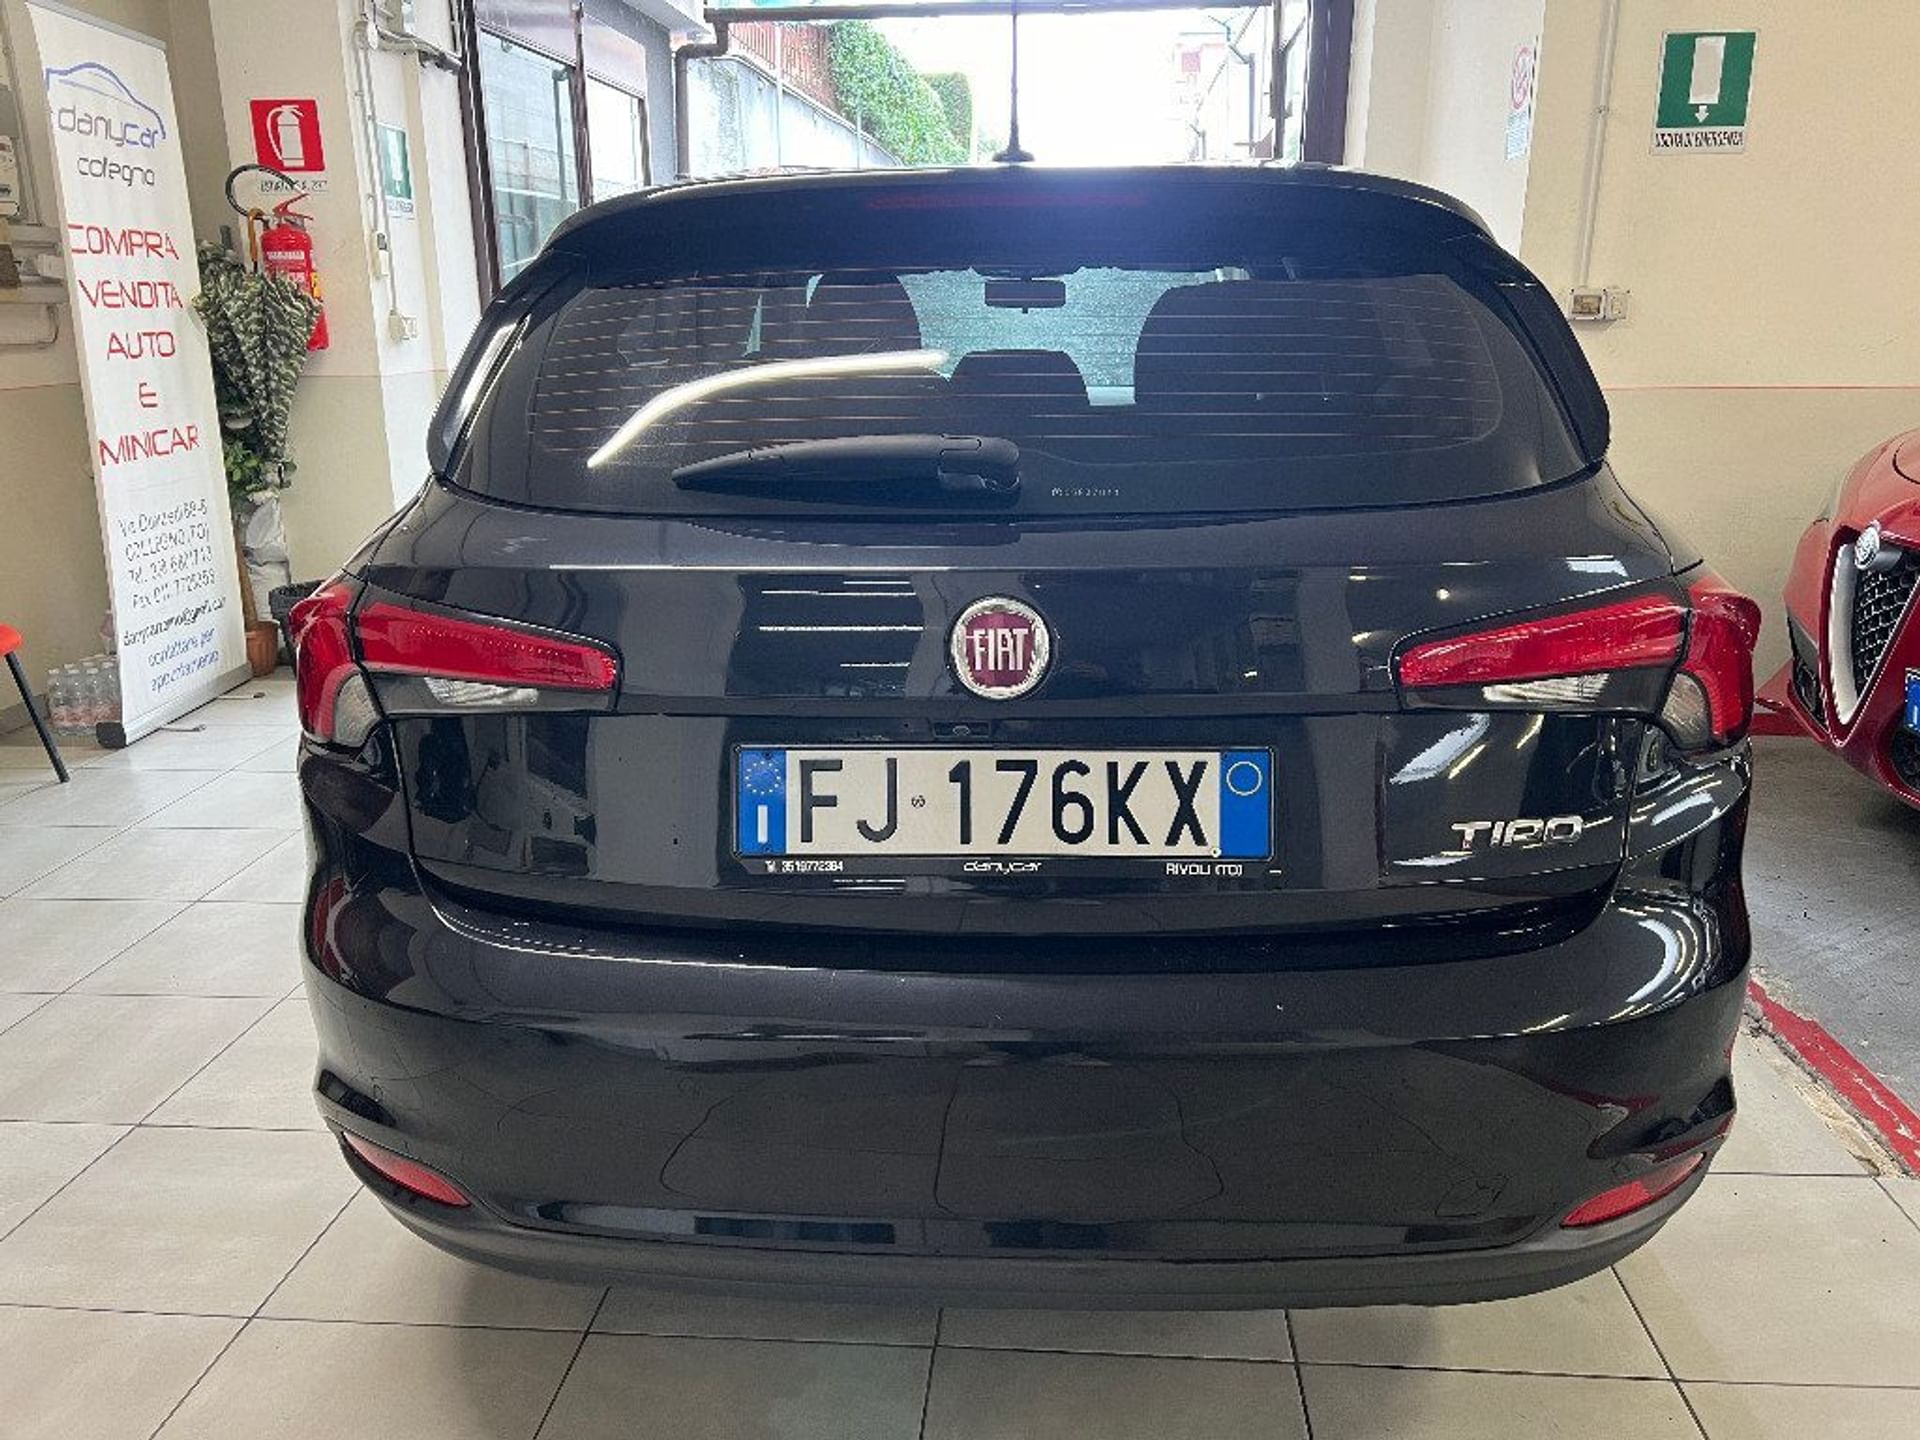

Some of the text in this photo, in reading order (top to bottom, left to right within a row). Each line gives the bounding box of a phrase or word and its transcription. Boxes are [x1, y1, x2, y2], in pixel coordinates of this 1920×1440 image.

[68, 223, 180, 260] COMPRA
[78, 279, 184, 309] VENDITA
[107, 331, 176, 360] AUTO
[138, 382, 158, 408] E
[98, 424, 200, 466] MINICAR
[973, 628, 1029, 671] FIAT
[1451, 815, 1583, 849] TIPO
